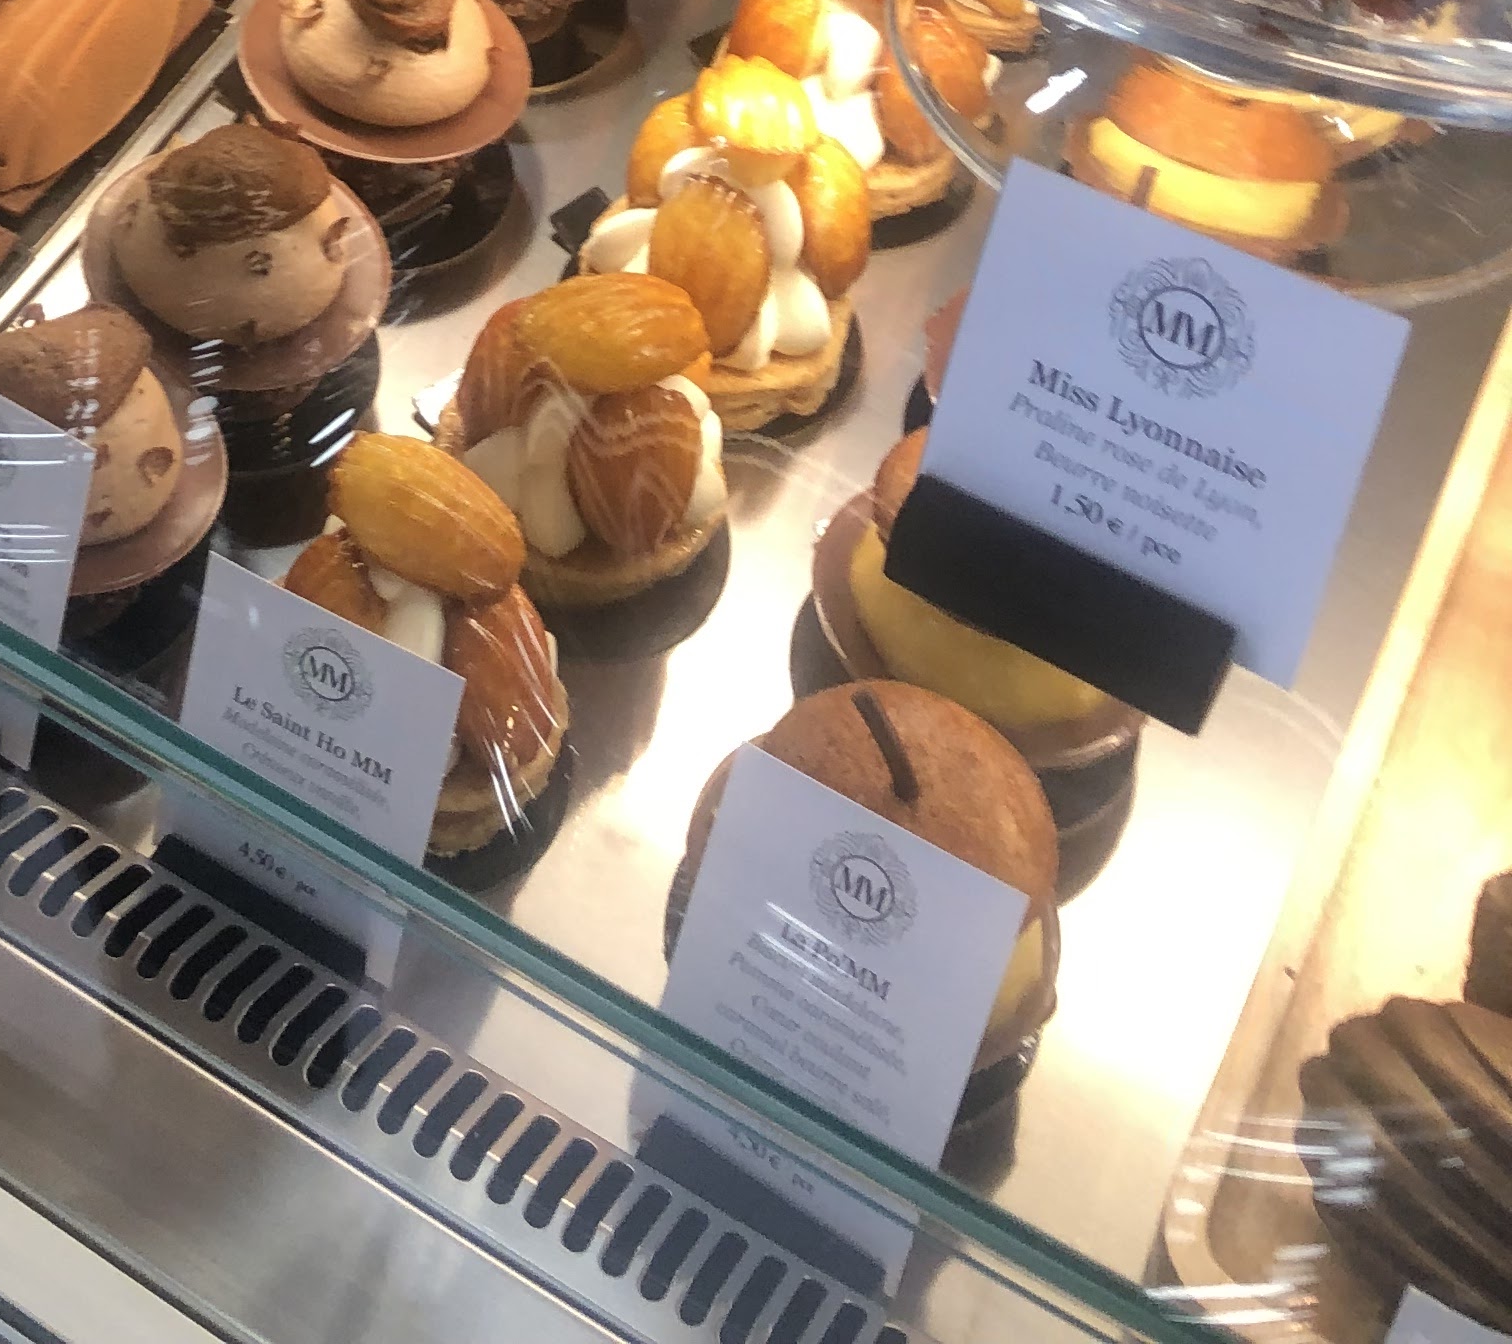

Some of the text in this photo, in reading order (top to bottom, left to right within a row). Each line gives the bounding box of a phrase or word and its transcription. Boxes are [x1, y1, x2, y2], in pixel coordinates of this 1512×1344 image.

[1143, 300, 1217, 358] MM
[1028, 359, 1267, 489] Miss Lyonnaise
[304, 655, 349, 693] MM
[233, 686, 258, 711] Le
[260, 701, 311, 742] Saint
[316, 730, 346, 760] Ho
[350, 749, 394, 785] MM
[835, 864, 889, 913] MM
